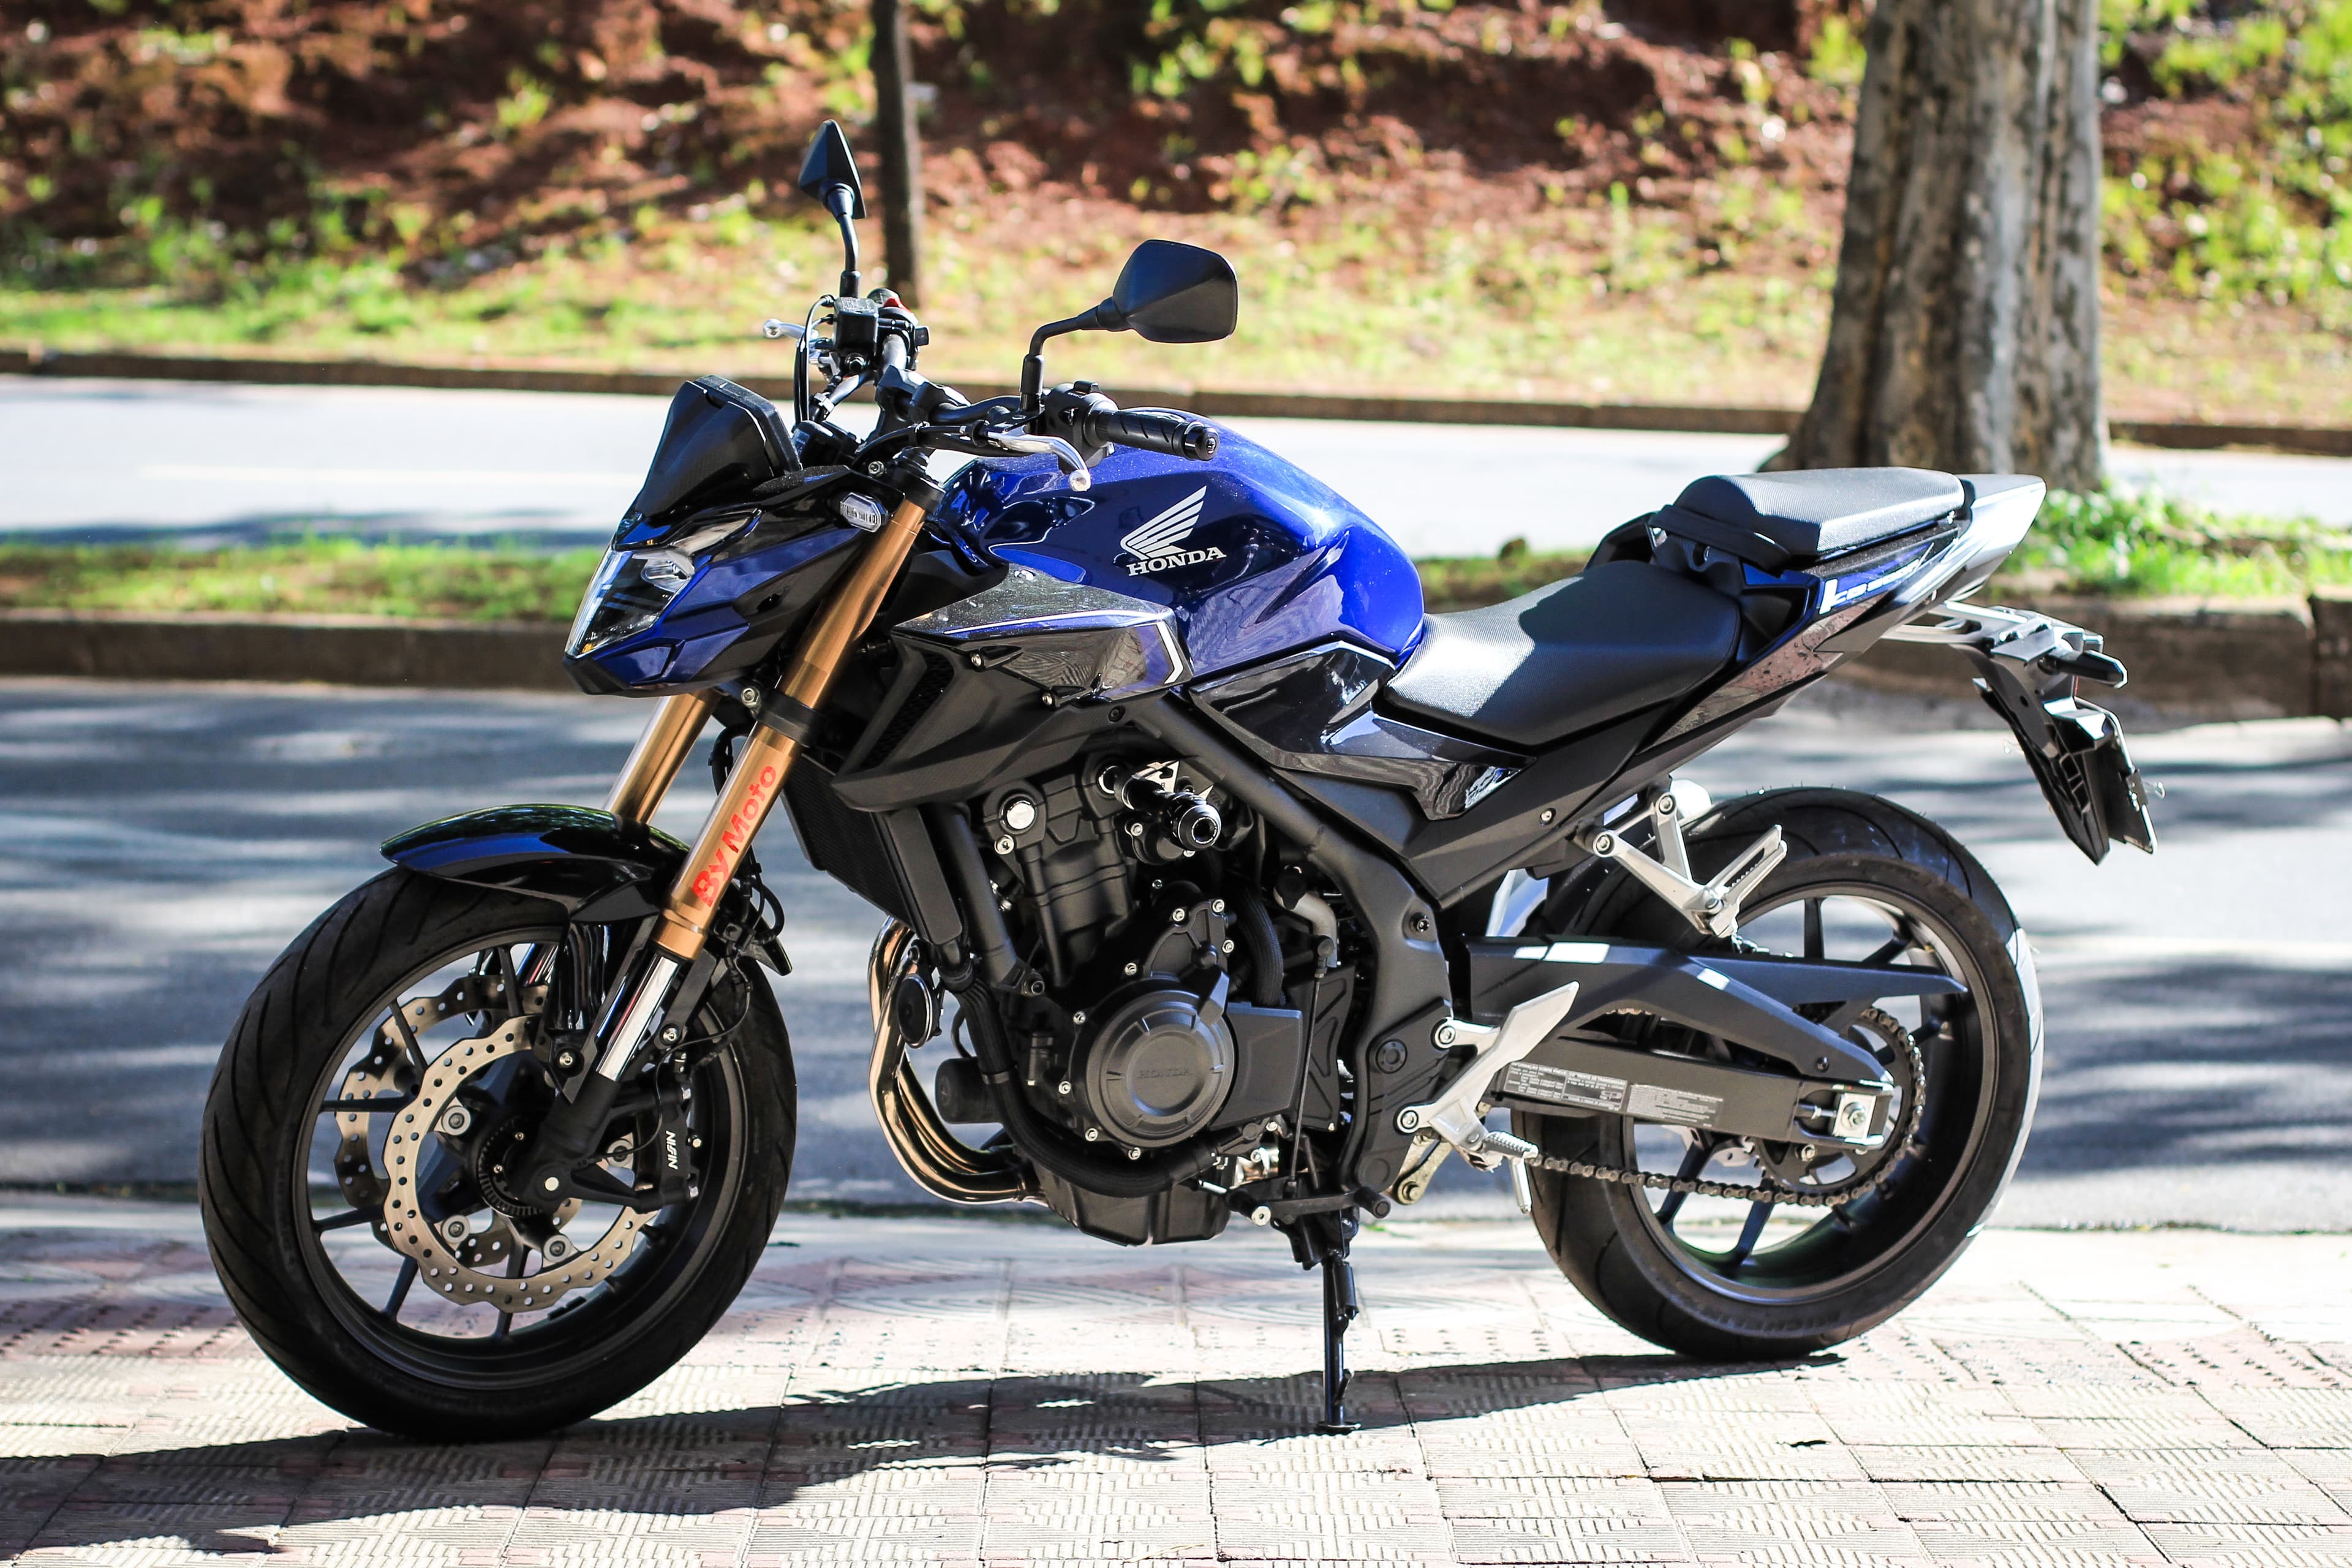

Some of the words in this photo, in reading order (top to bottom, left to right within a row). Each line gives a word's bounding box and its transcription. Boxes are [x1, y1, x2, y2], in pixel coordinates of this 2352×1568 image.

[1126, 546, 1227, 576] HONDA
[722, 766, 777, 853] Moto
[1136, 1068, 1194, 1079] HONDA
